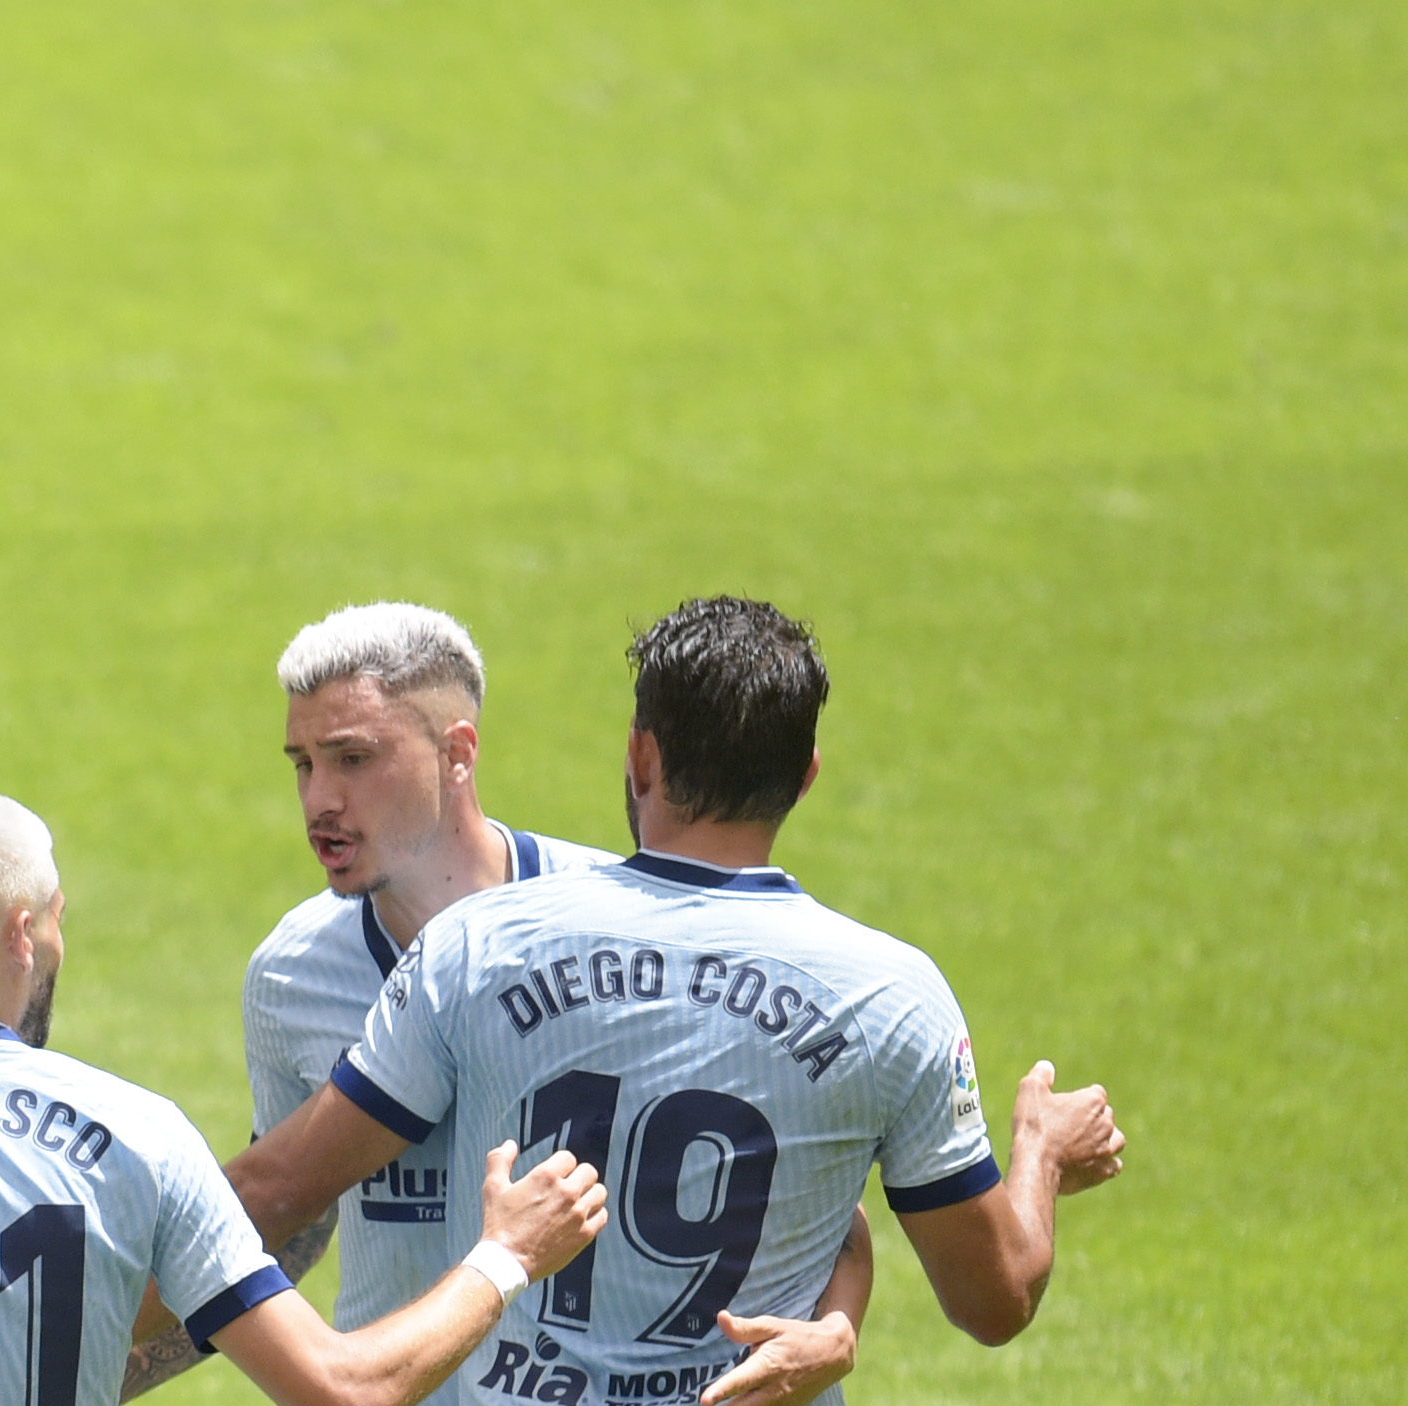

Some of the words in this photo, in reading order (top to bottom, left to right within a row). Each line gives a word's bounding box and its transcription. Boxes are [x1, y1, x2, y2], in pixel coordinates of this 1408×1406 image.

[497, 949, 665, 1039] DIEGO
[686, 956, 849, 1084] COSTA
[519, 1069, 778, 1350] 19
